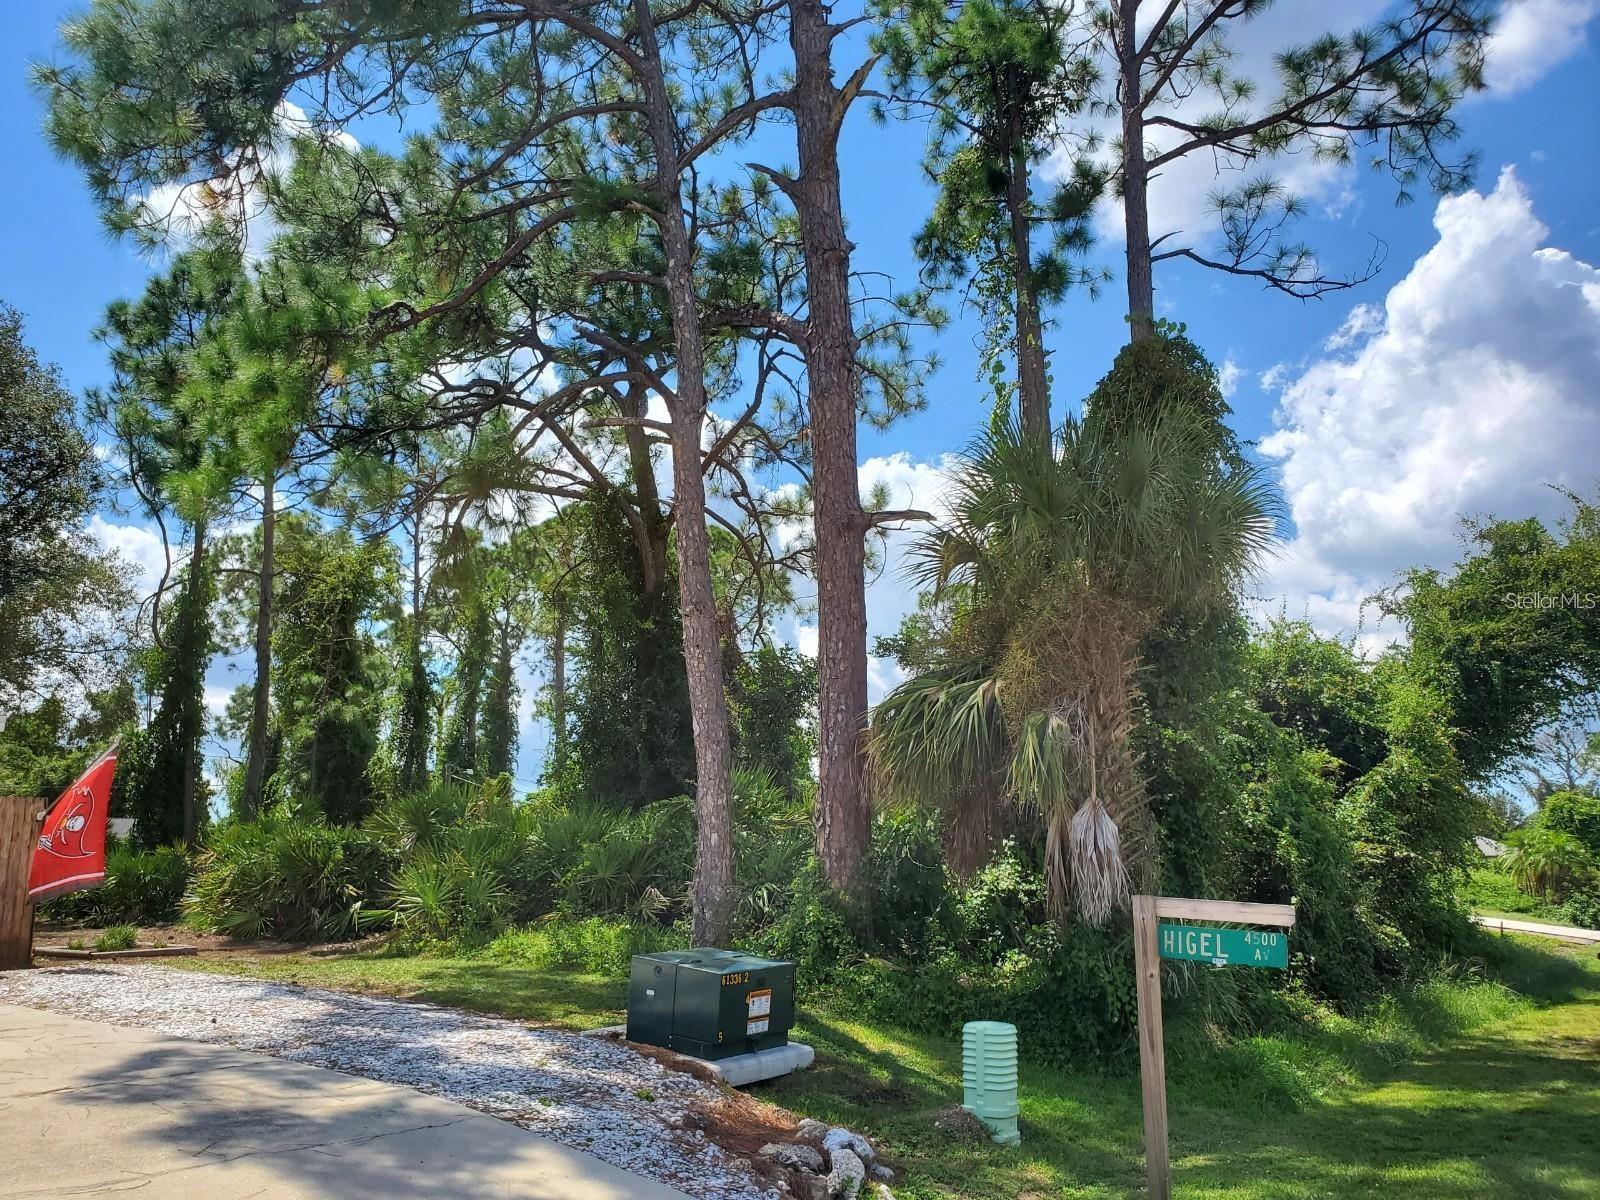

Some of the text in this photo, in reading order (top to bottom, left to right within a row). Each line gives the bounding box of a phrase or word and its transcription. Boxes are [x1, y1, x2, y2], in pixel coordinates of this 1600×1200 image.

[1164, 930, 1229, 958] HIGEL
[1244, 932, 1277, 946] 4500
[718, 1031, 723, 1042] 5
